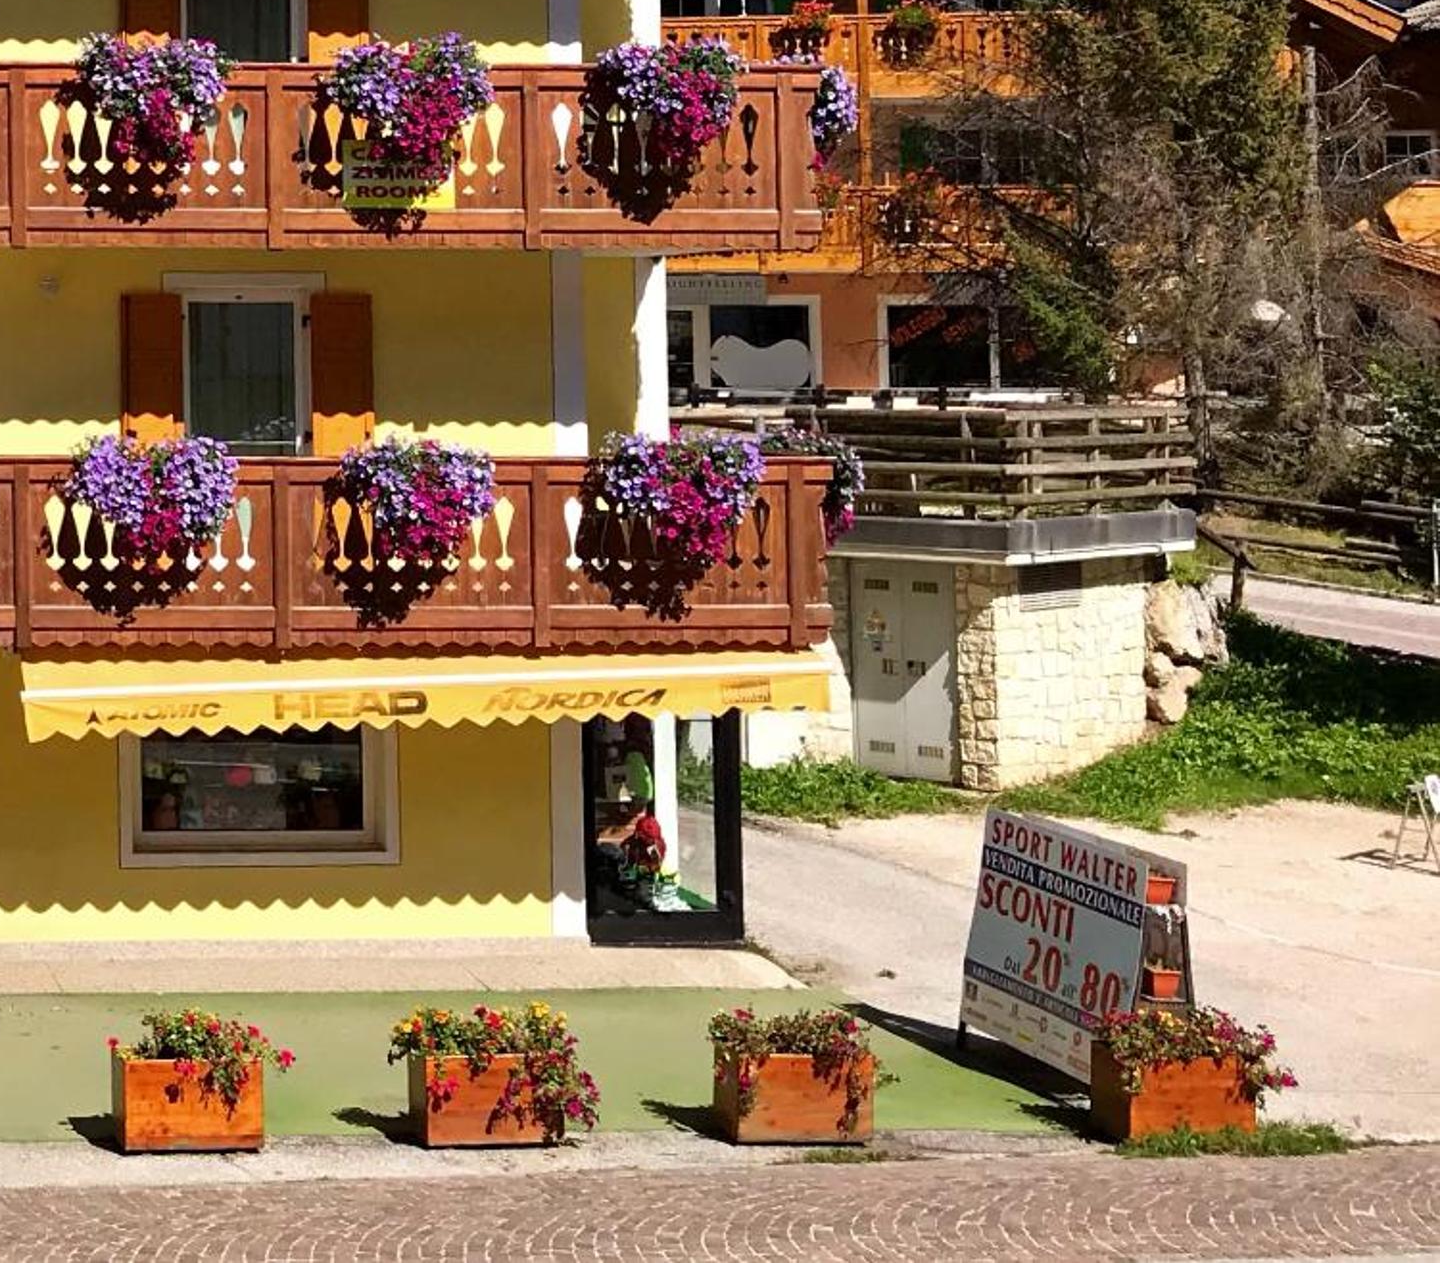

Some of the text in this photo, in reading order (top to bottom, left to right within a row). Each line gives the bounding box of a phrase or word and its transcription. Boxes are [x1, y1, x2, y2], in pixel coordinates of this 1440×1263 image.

[274, 690, 429, 720] HEAD
[482, 688, 668, 712] NORDICA
[984, 849, 1142, 924] VENDITA PROMOZIONALE
[991, 818, 1138, 897] SPORT WALTER
[980, 873, 1075, 943] SCONTI
